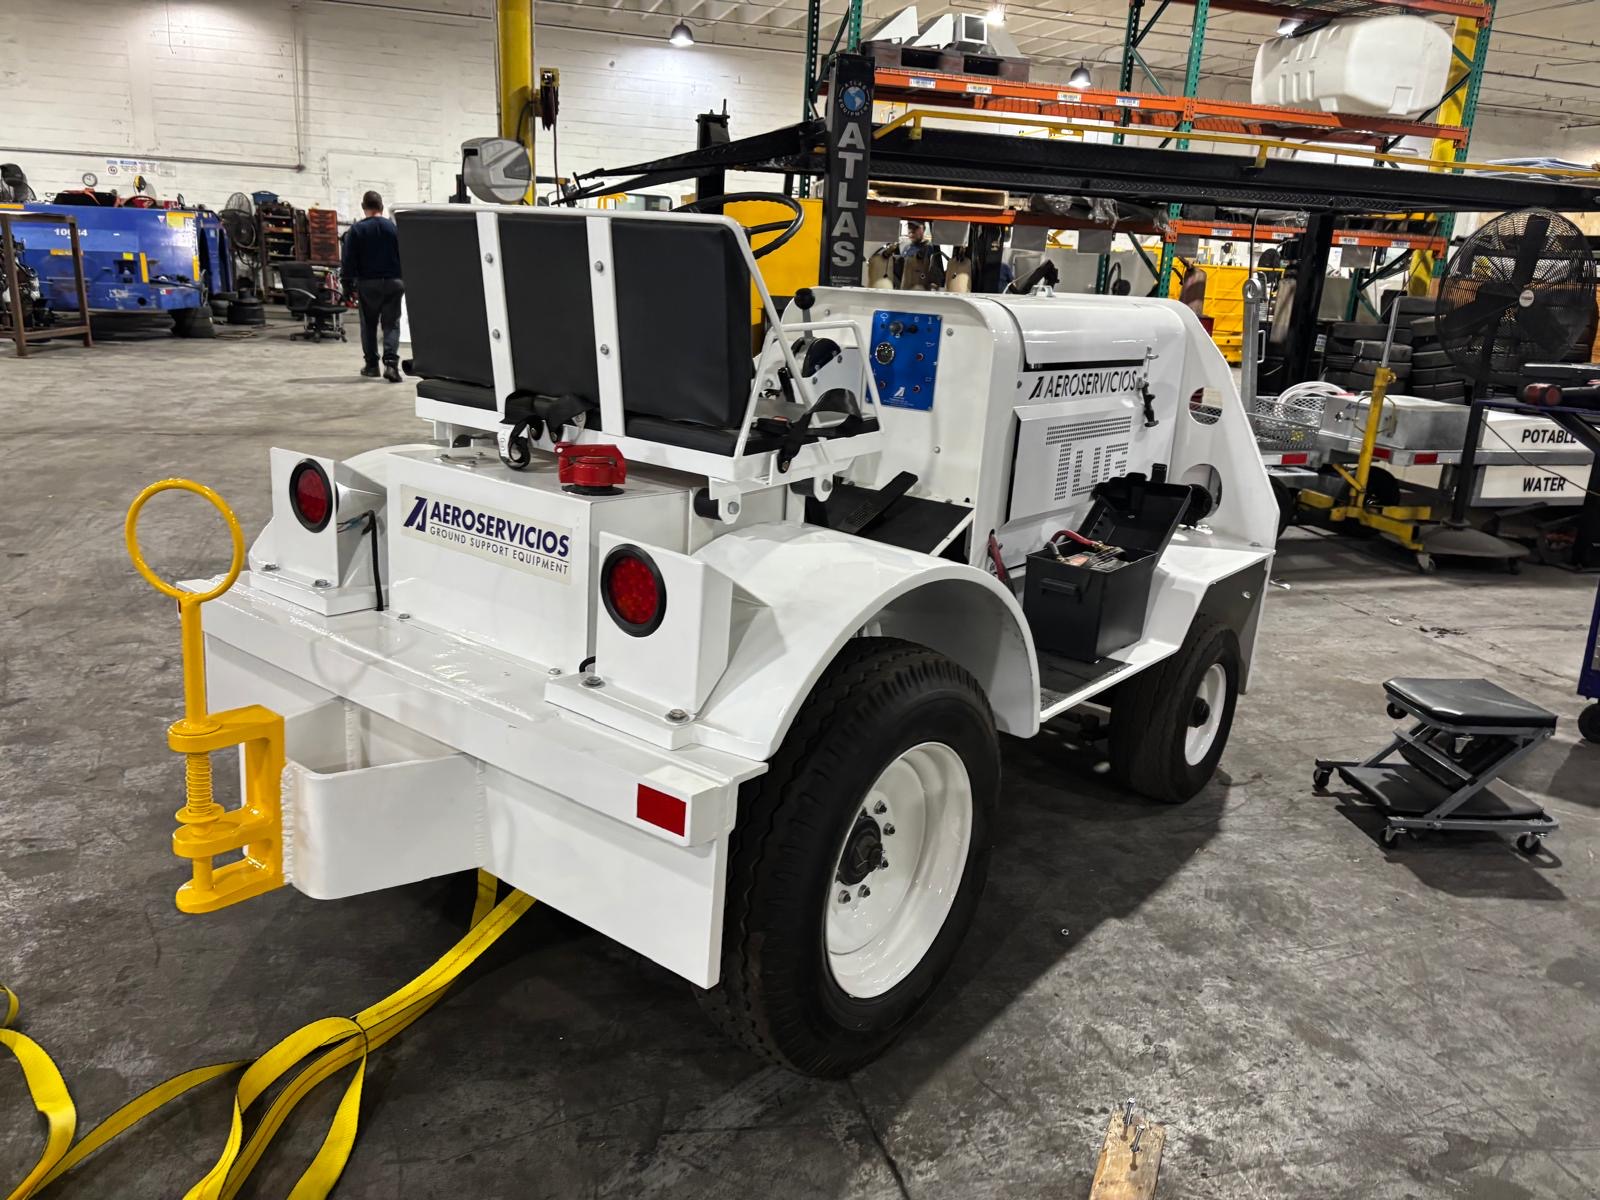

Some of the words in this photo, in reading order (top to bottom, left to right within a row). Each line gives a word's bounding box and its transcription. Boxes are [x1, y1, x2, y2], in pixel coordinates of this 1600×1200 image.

[831, 122, 866, 267] ATLAS
[1044, 370, 1137, 399] AEROSERVICIOS
[1045, 415, 1132, 501] TUG
[1522, 476, 1567, 493] WATER
[429, 501, 570, 558] AEROSERVICIOS
[430, 526, 467, 544] GROUND
[470, 537, 509, 557] SUPPORT
[512, 549, 569, 575] EQUIPMENT
